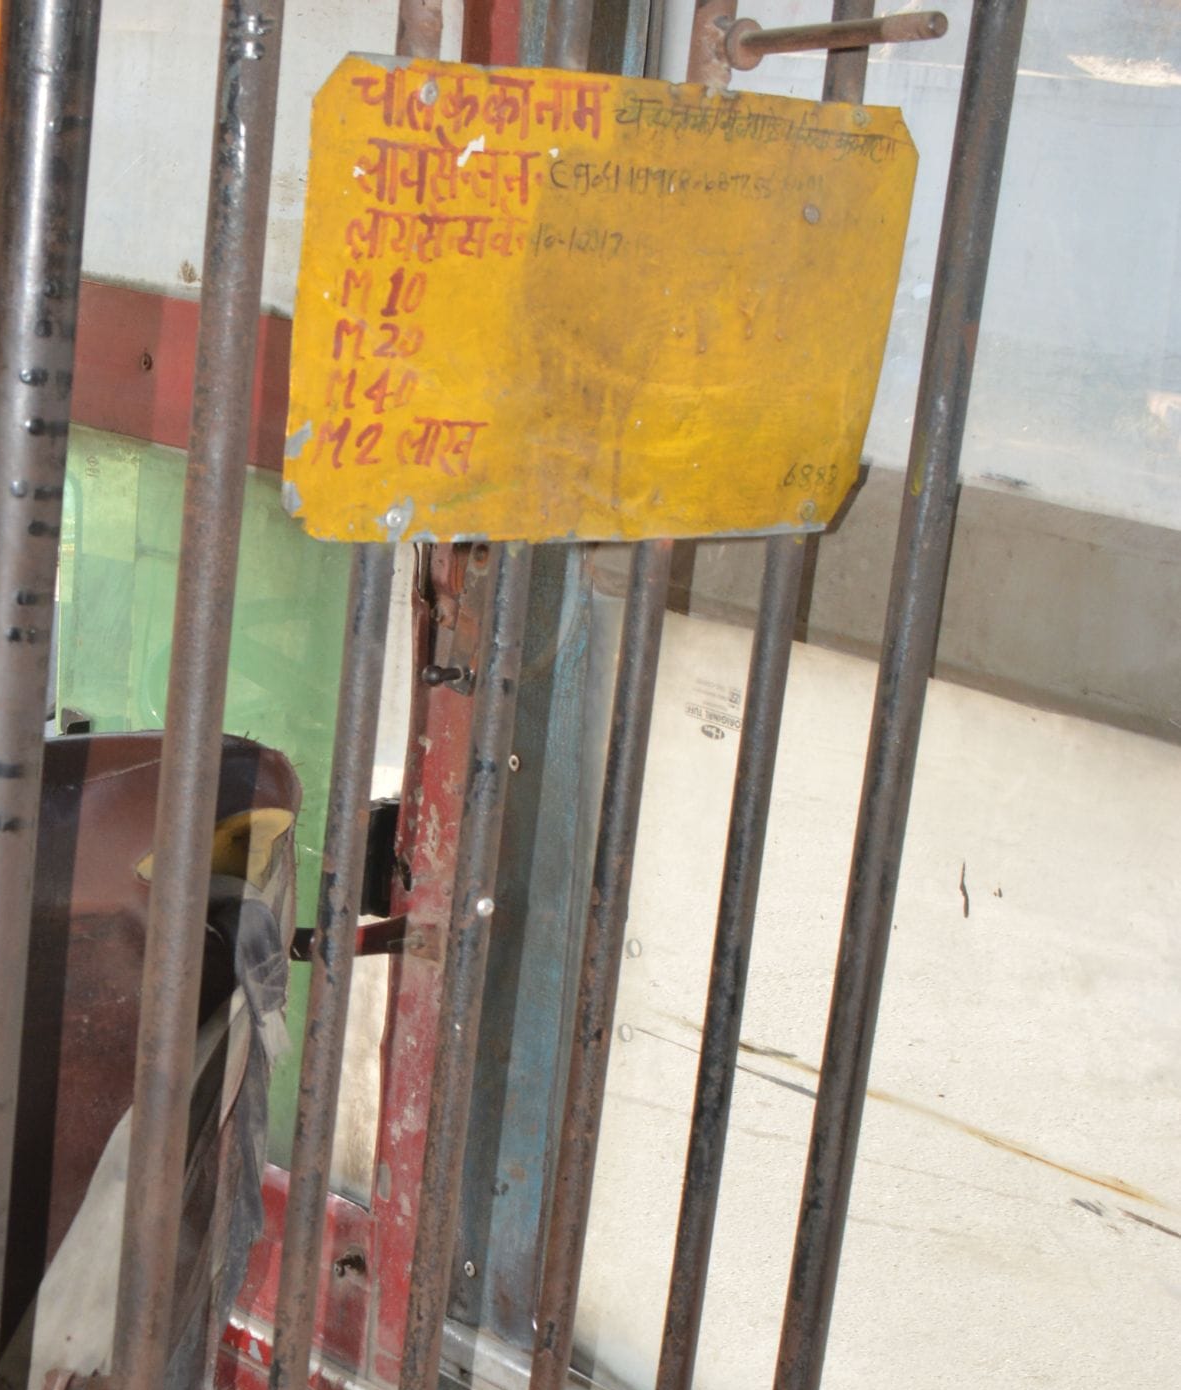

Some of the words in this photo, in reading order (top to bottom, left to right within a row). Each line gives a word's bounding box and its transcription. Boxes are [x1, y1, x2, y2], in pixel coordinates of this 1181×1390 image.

[341, 268, 371, 313] M
[380, 267, 428, 317] 10
[332, 319, 367, 361] M
[372, 322, 425, 359] 20
[325, 367, 357, 409] M
[310, 417, 352, 469] M
[355, 422, 384, 465] 2
